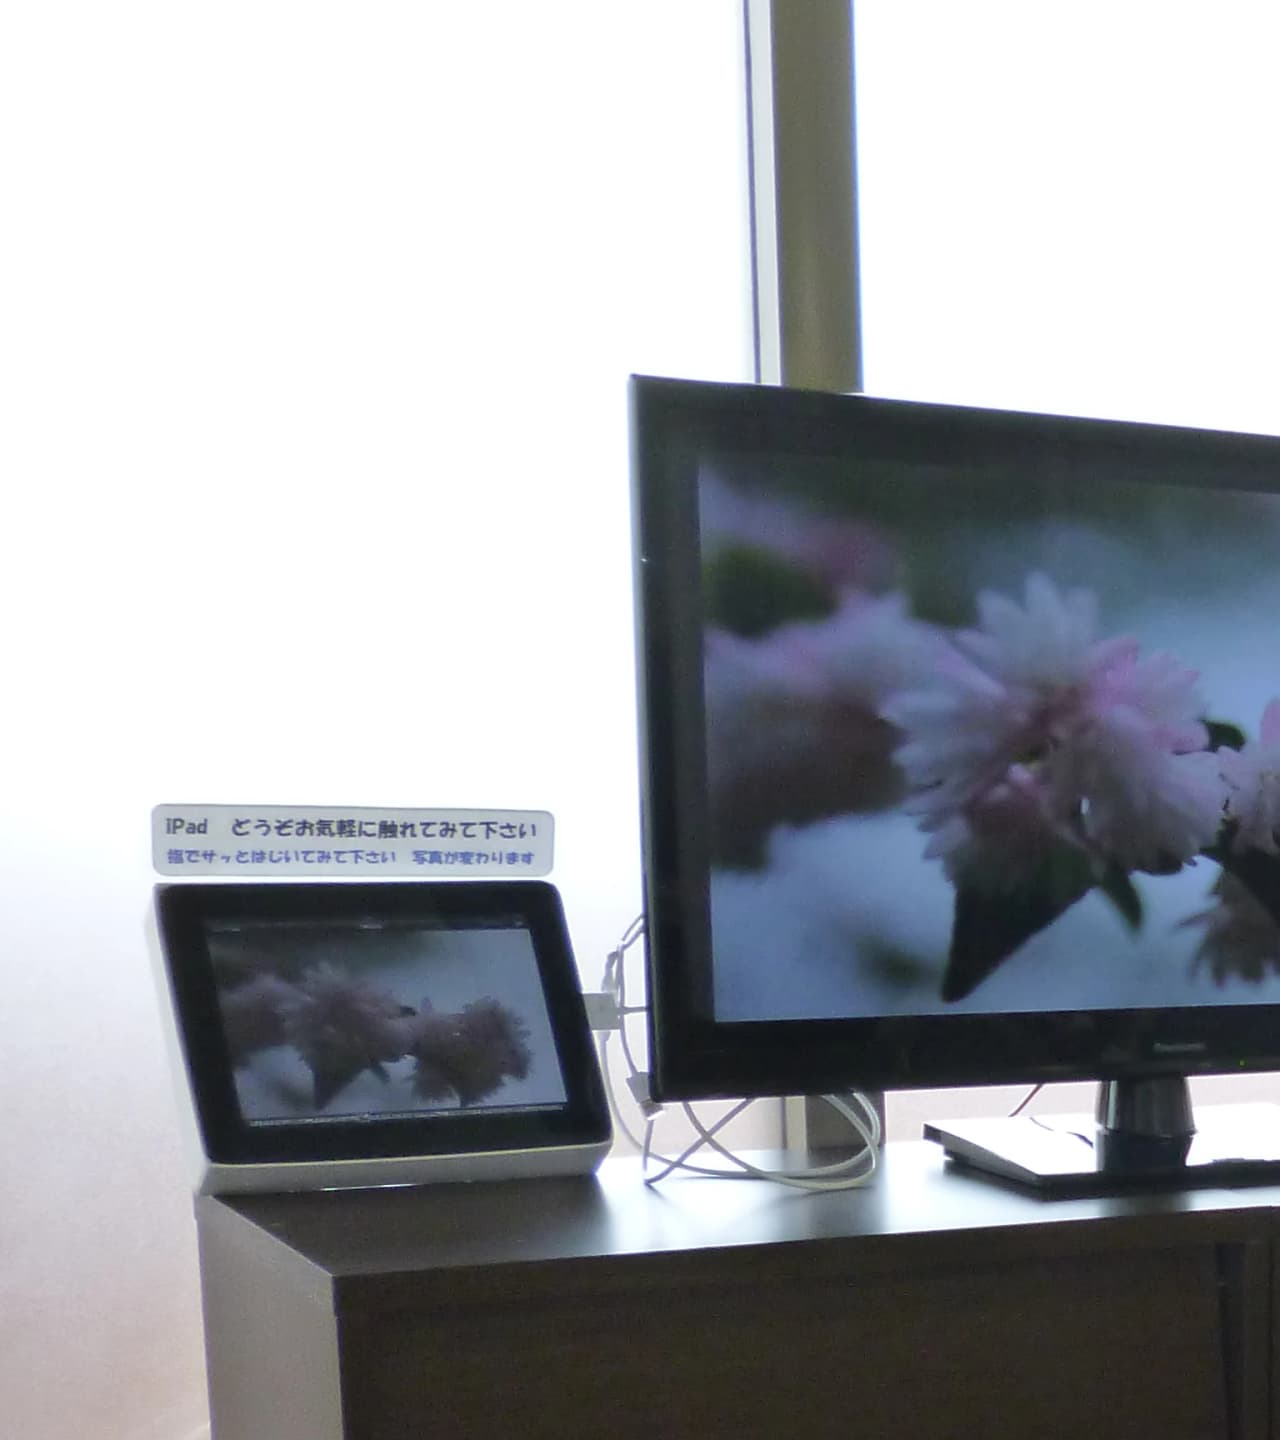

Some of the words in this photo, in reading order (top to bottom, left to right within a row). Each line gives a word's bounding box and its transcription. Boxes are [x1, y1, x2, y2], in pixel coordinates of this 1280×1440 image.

[165, 817, 209, 836] iPad
[230, 819, 538, 841] どうぞお気軽に触れてみて下さい
[166, 848, 398, 866] 指でサッとはじいてみて下さい
[411, 849, 536, 866] 写真が変わります
